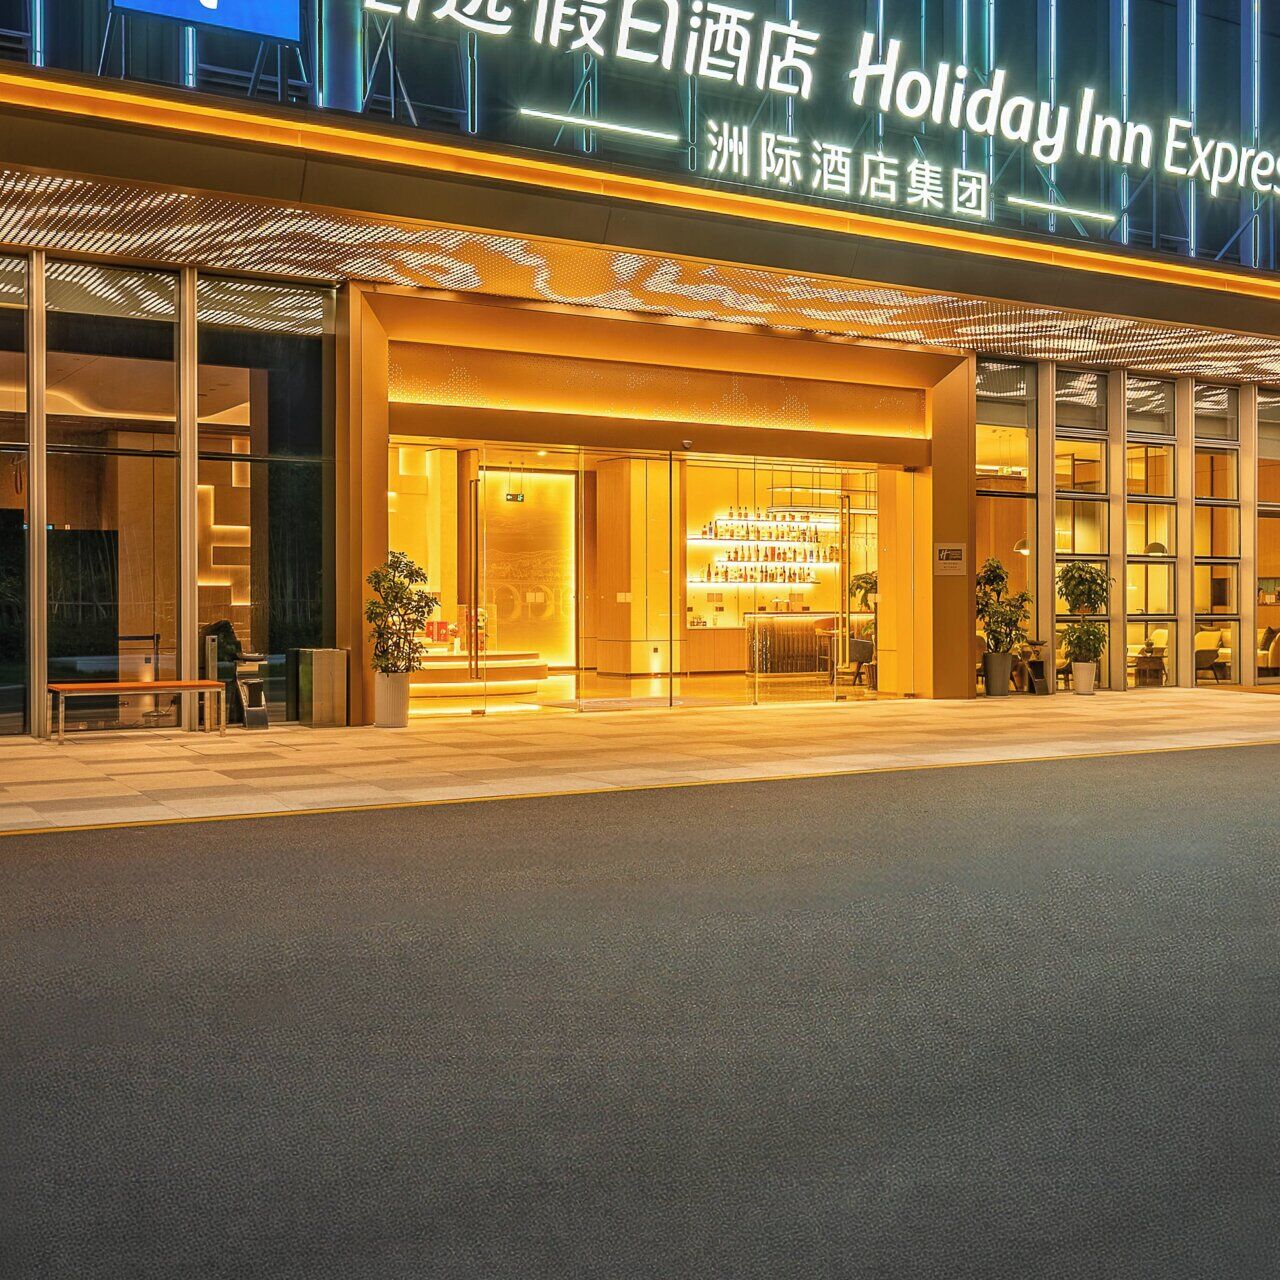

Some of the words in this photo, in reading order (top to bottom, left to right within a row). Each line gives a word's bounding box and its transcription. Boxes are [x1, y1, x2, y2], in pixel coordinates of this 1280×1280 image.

[848, 31, 1070, 165] Holiday
[1075, 87, 1153, 169] Inn
[706, 119, 988, 219] 洲际酒店集团
